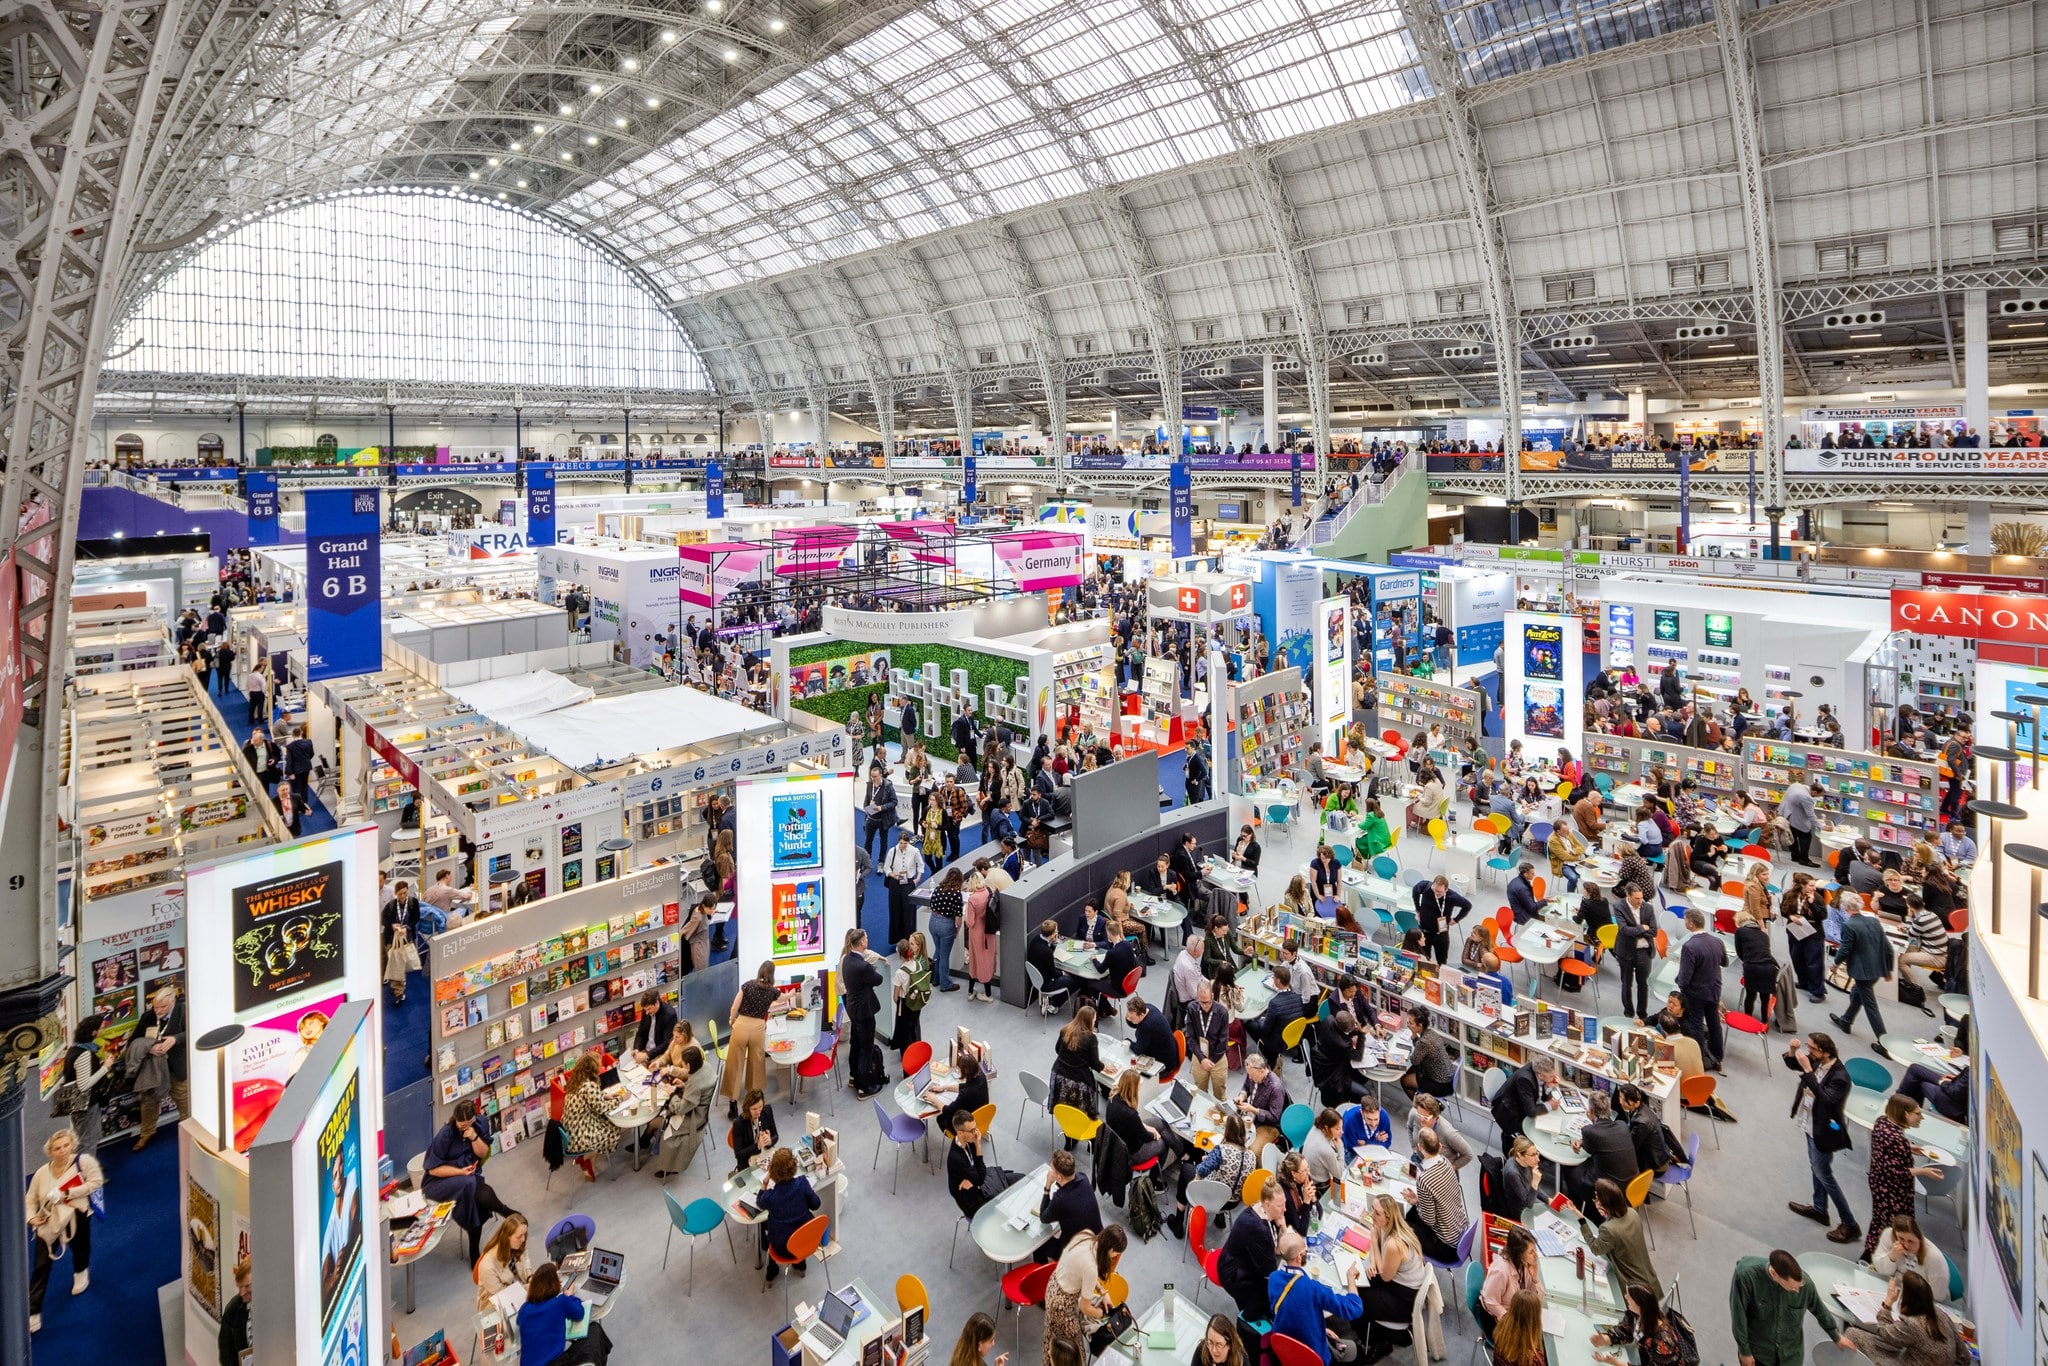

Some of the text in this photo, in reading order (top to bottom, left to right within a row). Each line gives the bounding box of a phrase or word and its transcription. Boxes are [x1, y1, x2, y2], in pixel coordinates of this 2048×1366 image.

[552, 461, 592, 470] GREECE
[1841, 461, 1981, 469] PUBLISHER SERVICES
[252, 492, 273, 500] Grand
[427, 491, 444, 500] Exit
[709, 488, 722, 496] 6 D
[1174, 488, 1189, 496] Grand
[1176, 496, 1187, 504] Hall
[253, 505, 273, 516] 6 B
[532, 503, 551, 515] 6 C
[1174, 506, 1189, 518] 6 D
[479, 528, 569, 550] FRAE
[318, 538, 369, 554] Grand
[327, 555, 361, 570] Hall
[787, 551, 836, 561] Germany
[1025, 555, 1072, 570] Germany
[1611, 555, 1653, 567] HURST
[1668, 558, 1699, 569] stison
[598, 565, 619, 578] INGRAM
[680, 566, 705, 586] Germany
[1574, 567, 1618, 576] COMPASS
[1575, 573, 1600, 581] GLA
[322, 575, 367, 598] 6 B
[1379, 578, 1415, 591] Gardners
[594, 596, 620, 612] The World
[594, 608, 620, 627] is Reading
[1899, 602, 2048, 631] CANON
[855, 620, 896, 630] MACAULEY
[899, 621, 949, 630] PUBLISHERS
[773, 793, 815, 803] PAULA SUTTON
[198, 807, 222, 816] HOME
[566, 799, 620, 817] FINDHORN PRESS
[198, 812, 230, 822] GARDEN
[110, 823, 135, 833] FOOD
[493, 823, 530, 836] FINDHORN
[778, 821, 812, 834] Potting
[113, 829, 140, 840] DRINK
[783, 830, 807, 841] Shed
[778, 840, 812, 853] Murder
[635, 871, 675, 888] hachette
[244, 893, 263, 904] THE
[264, 885, 292, 899] WORLD
[294, 879, 318, 893] ATLAS
[318, 874, 330, 885] OF
[249, 883, 327, 917] WHISKY
[781, 892, 812, 904] RACHEL
[151, 900, 182, 917] FOX
[781, 905, 812, 917] WEISS'S
[783, 919, 810, 929] GROUP
[101, 931, 130, 946] NEW
[131, 919, 176, 939] TITLES!
[458, 923, 504, 947] hachette
[787, 932, 807, 942] CHAT
[268, 971, 311, 991] DAVE BROOM
[276, 995, 306, 1010] Octopus
[242, 1037, 281, 1056] TAYLOR
[242, 1047, 272, 1063] SWIFT
[318, 1075, 357, 1157] TOMMY
[325, 1107, 352, 1171] FURY
